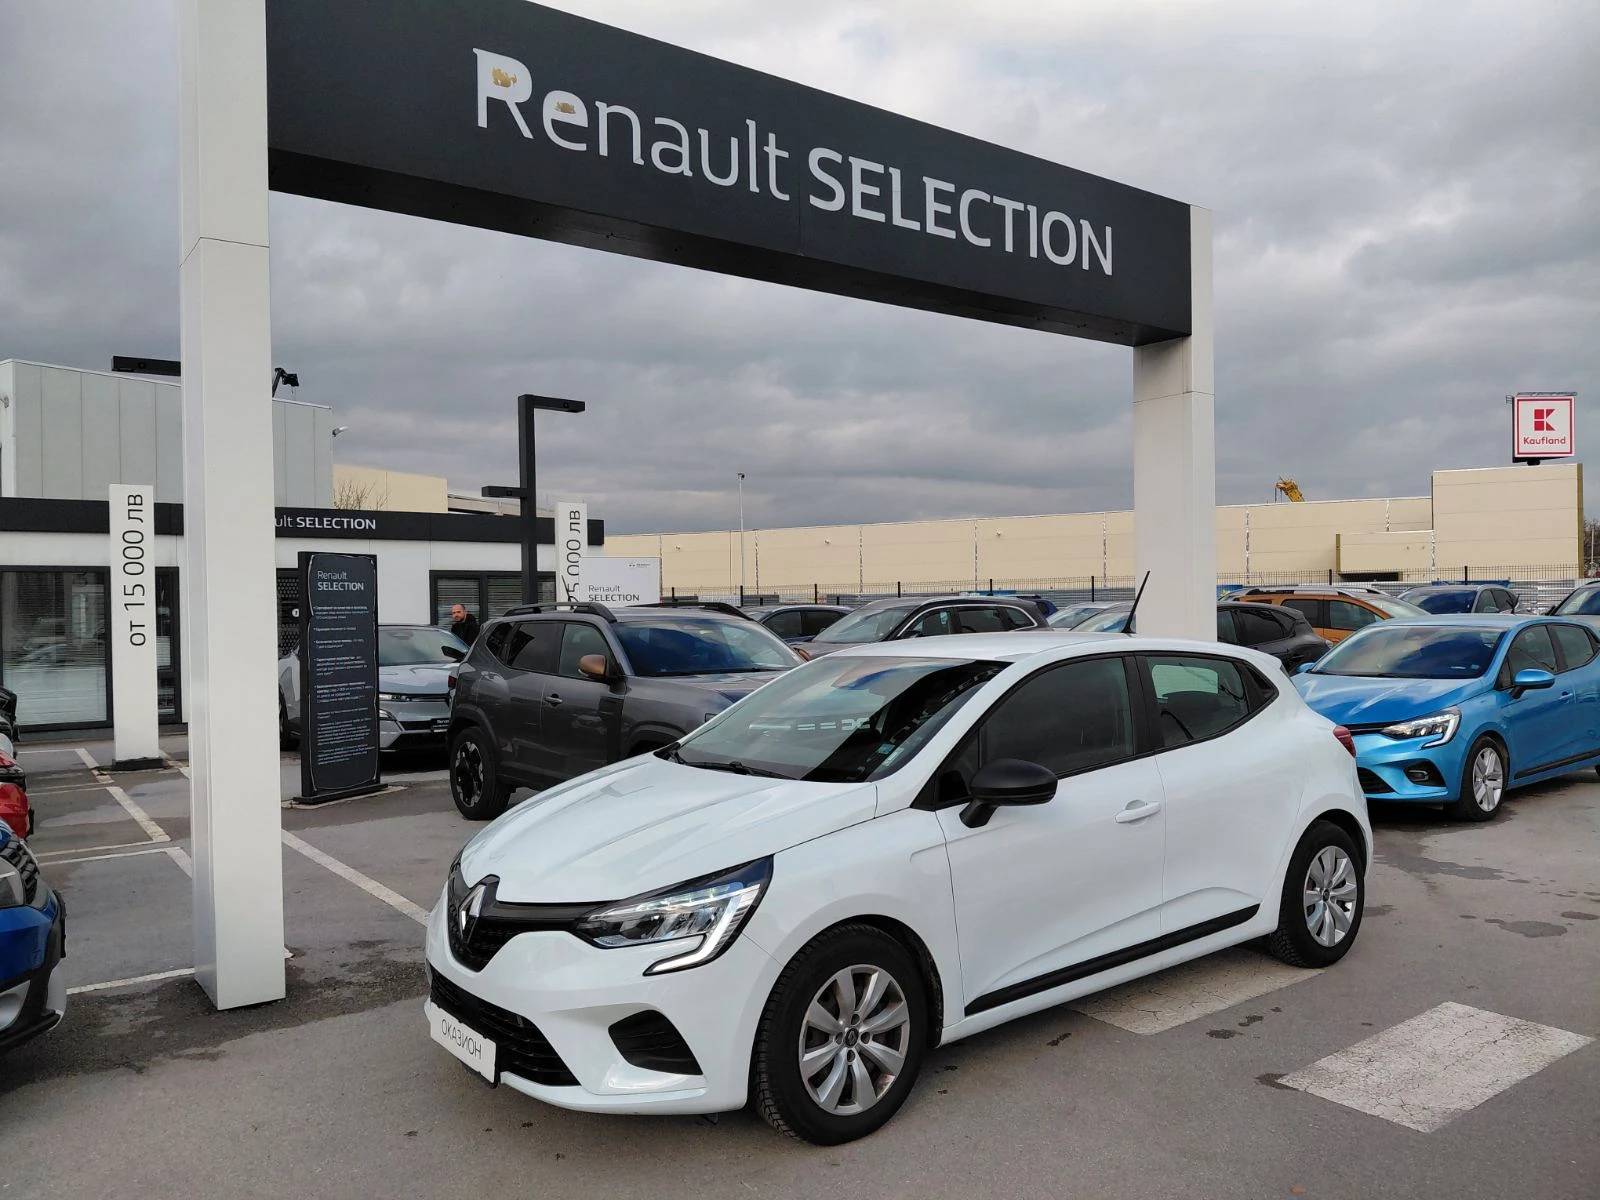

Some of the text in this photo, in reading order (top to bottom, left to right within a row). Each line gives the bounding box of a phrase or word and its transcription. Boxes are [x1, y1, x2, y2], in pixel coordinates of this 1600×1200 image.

[472, 47, 1113, 276] Renault SELECTION
[1523, 436, 1566, 445] Kaufland
[296, 516, 376, 530] SELECTION
[122, 530, 145, 576] 000
[566, 539, 581, 576] 000
[317, 570, 347, 580] Renault
[317, 581, 364, 591] SELECTION
[588, 584, 620, 593] Renault
[123, 584, 145, 611] 15
[588, 594, 640, 602] SELECTION
[442, 1019, 481, 1060] ОКАЗИОН
